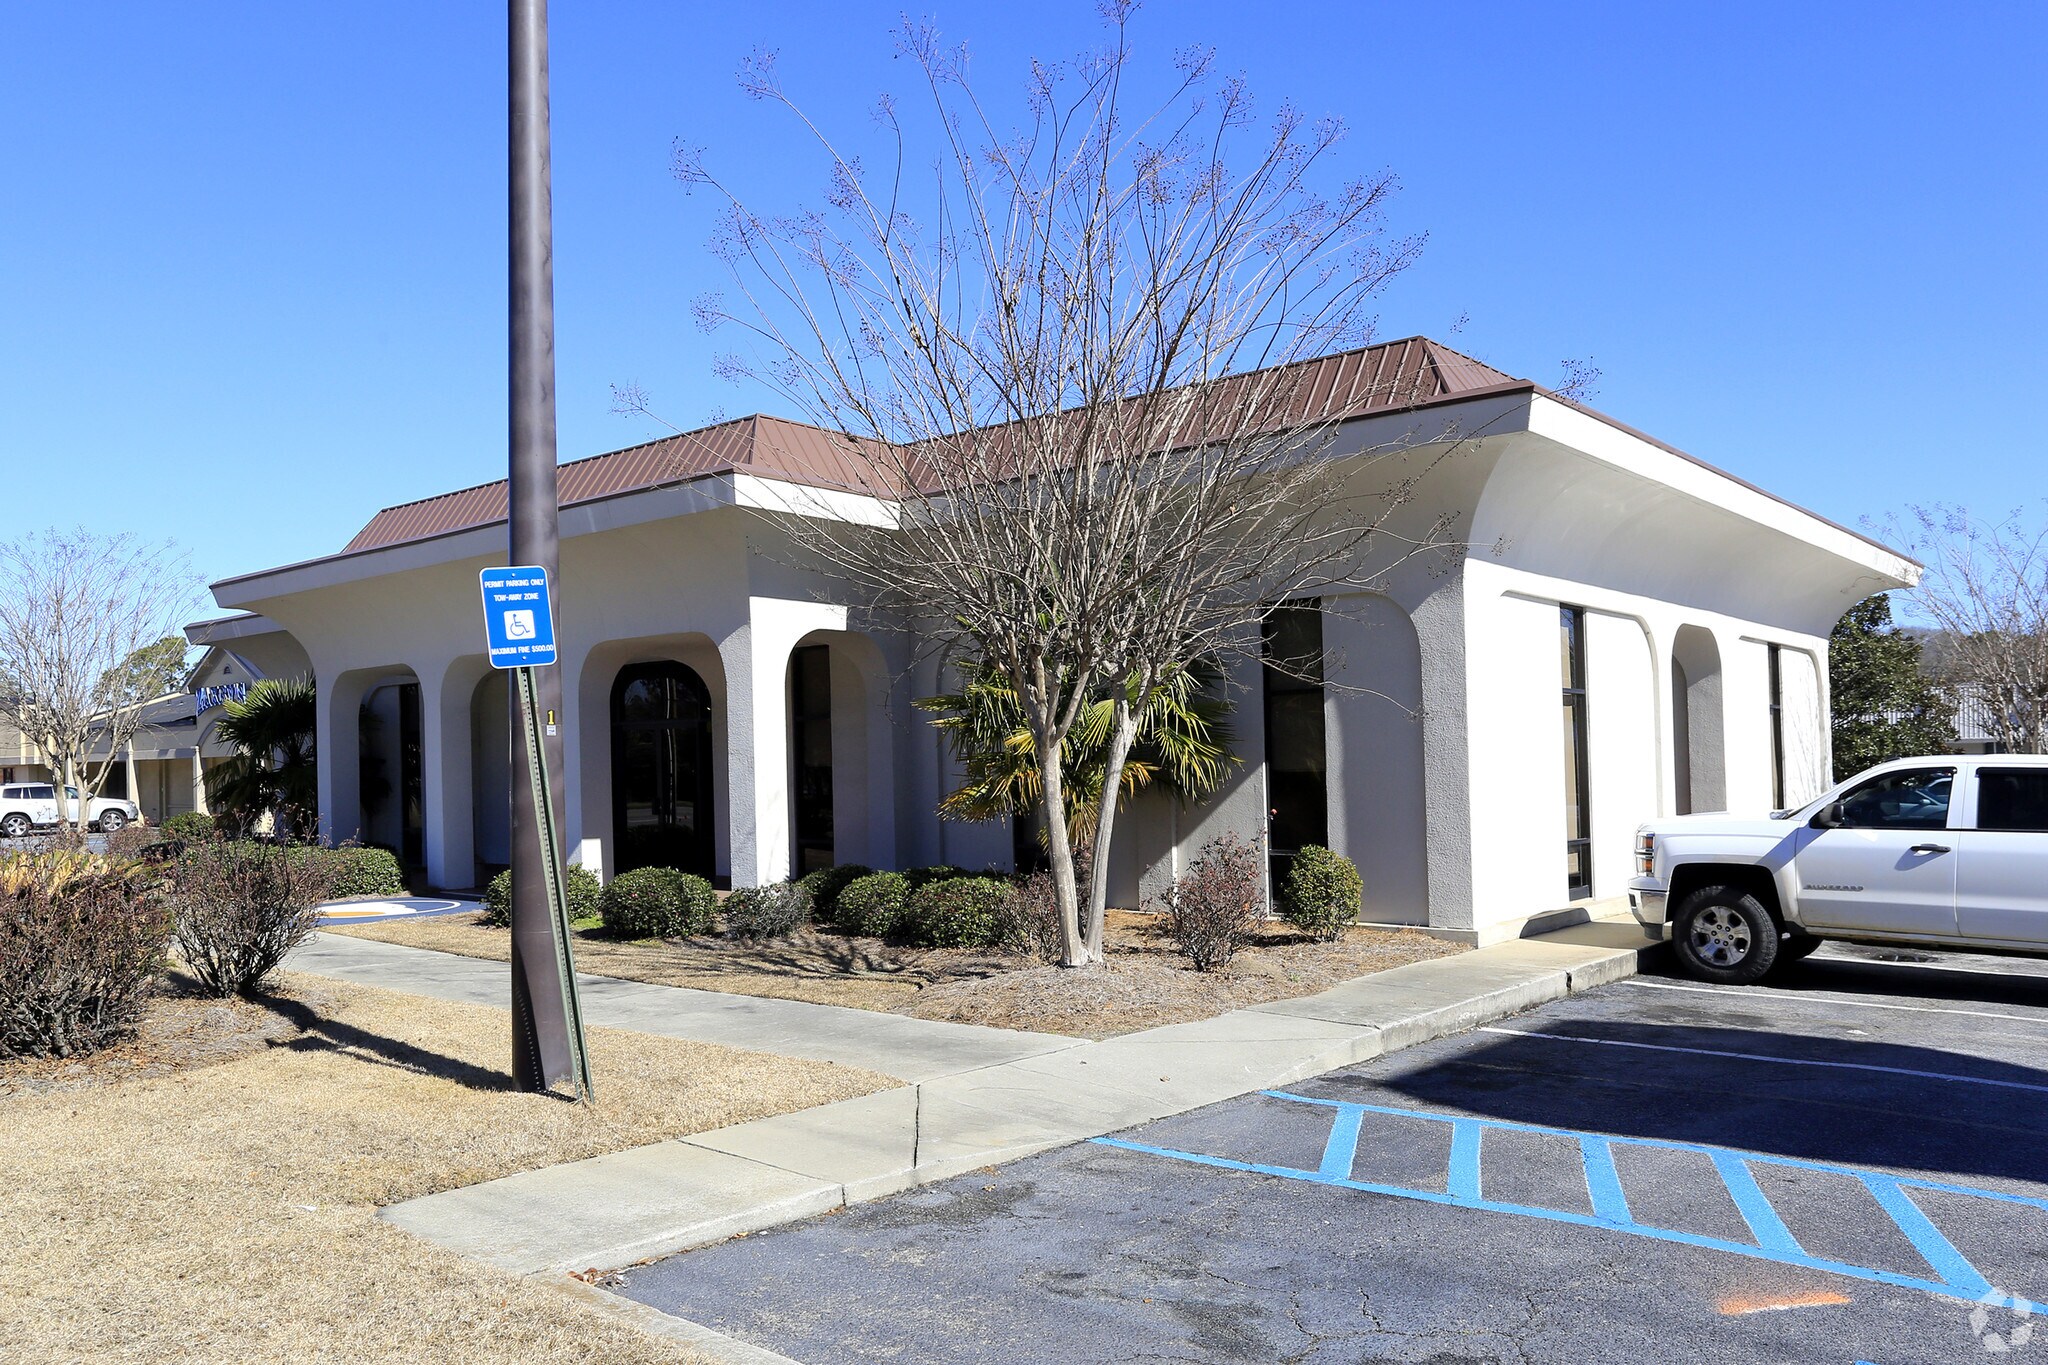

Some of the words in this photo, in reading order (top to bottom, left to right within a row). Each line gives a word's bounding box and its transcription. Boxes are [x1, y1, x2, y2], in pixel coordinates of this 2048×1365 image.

[506, 579, 529, 587] PARKING
[493, 593, 522, 601] TOW-AWAY
[524, 592, 539, 600] ZONE
[491, 647, 517, 655] MAXIMUM
[532, 644, 554, 652] $500.00
[548, 710, 555, 725] 1
